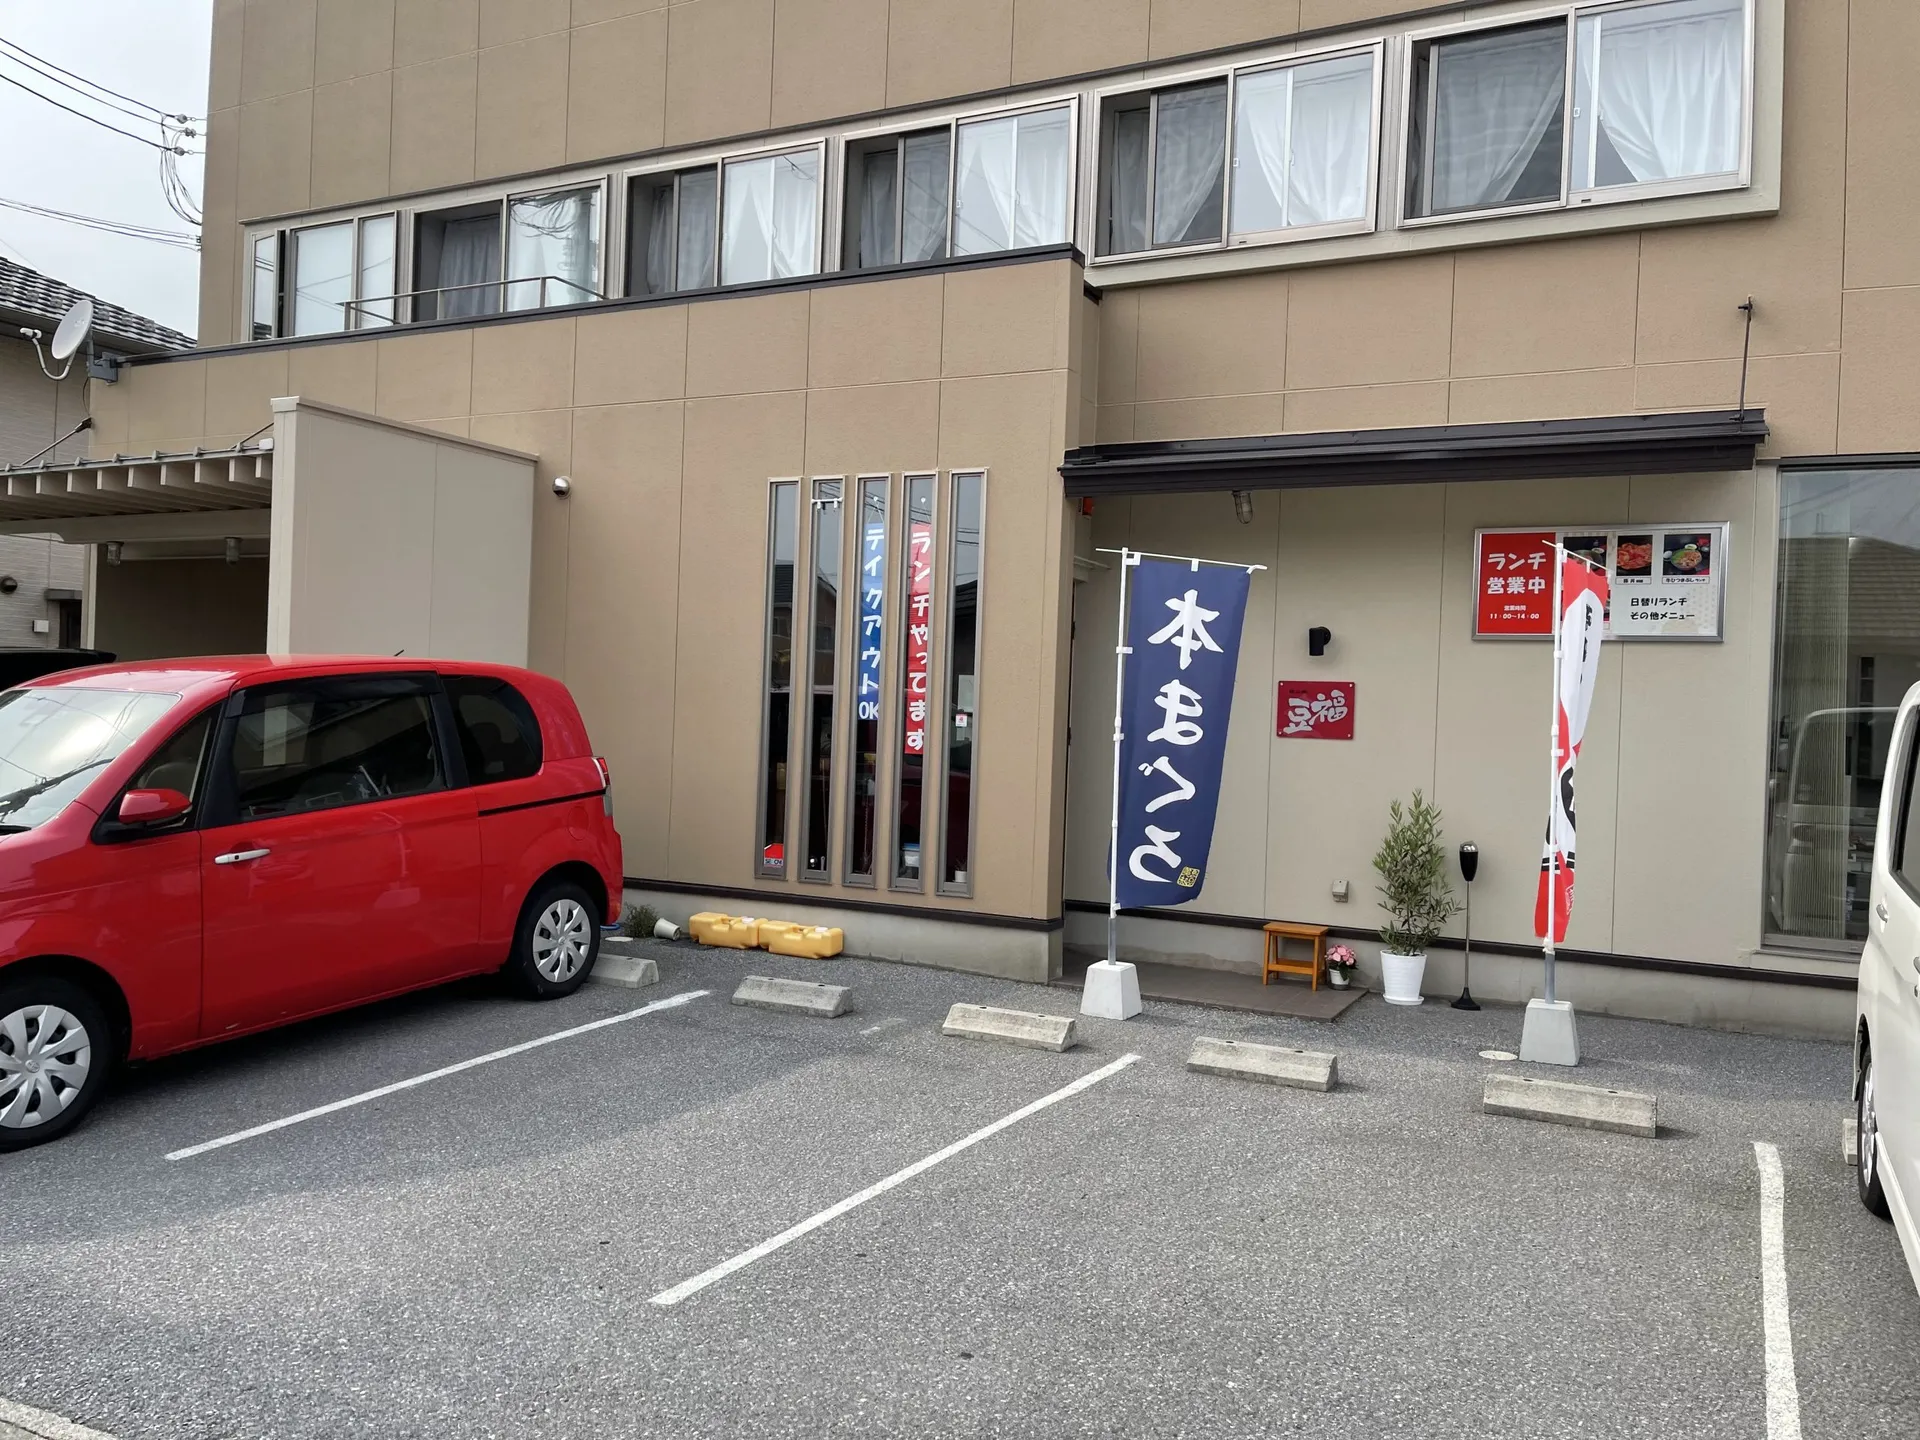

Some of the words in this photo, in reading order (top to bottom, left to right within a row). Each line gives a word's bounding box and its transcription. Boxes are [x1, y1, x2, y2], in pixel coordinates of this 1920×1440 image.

[1487, 551, 1547, 571] ランチ
[1487, 576, 1546, 594] 営業中
[1630, 597, 1688, 607] 日替りランチ
[1630, 611, 1696, 621] その他メニュー
[907, 531, 931, 751] ランチやってます
[1128, 588, 1224, 883] 本まぐろ
